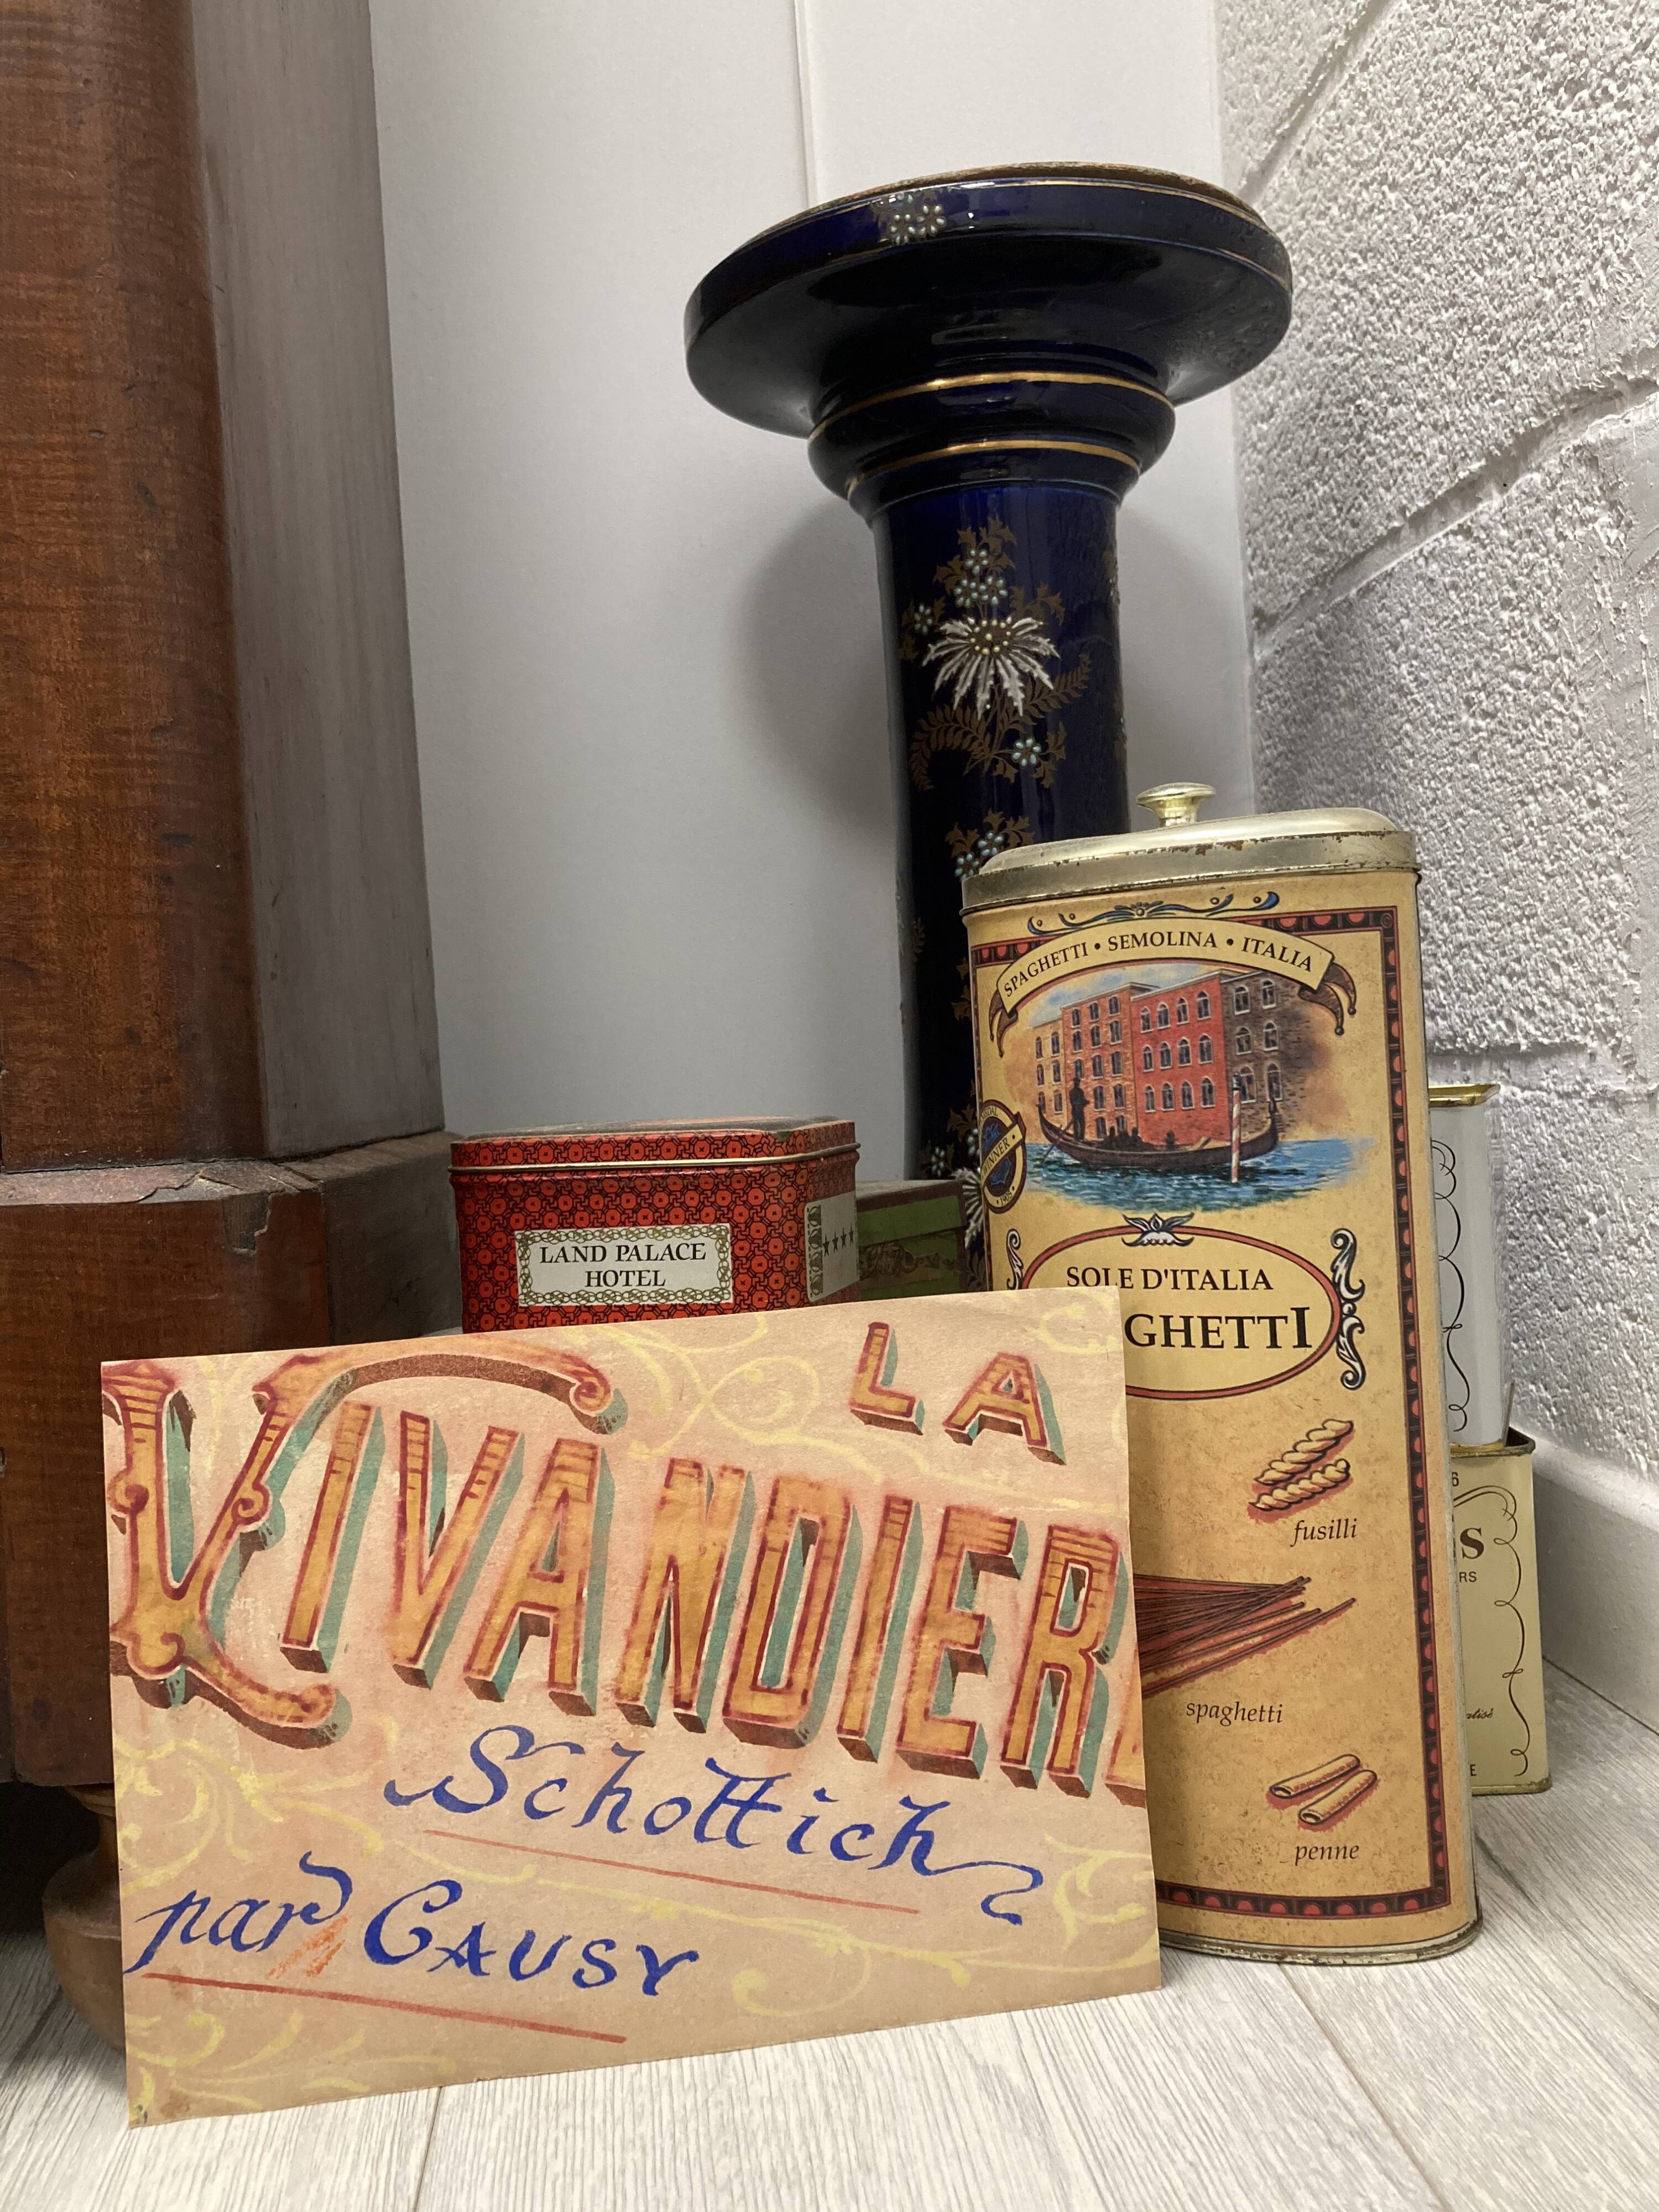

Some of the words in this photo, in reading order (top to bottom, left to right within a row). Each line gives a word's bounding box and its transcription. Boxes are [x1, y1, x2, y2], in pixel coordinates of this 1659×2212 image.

[1003, 941, 1089, 997] SPAGHETTI
[1108, 931, 1218, 951] SEMOLINA
[1243, 937, 1313, 973] ITALIA
[983, 1137, 1010, 1176] WINNER
[1000, 1189, 1013, 1206] 1905
[539, 1245, 607, 1264] LAND
[614, 1241, 707, 1263] PALACE
[585, 1269, 666, 1288] HOTEL
[1067, 1266, 1134, 1289] SOLE
[1141, 1267, 1274, 1291] D'ITALIA
[1124, 1306, 1313, 1349] GHETTI
[848, 1321, 1067, 1464] LA
[1290, 1519, 1357, 1547] fusilli
[1186, 1700, 1284, 1724] spaghetti
[383, 1723, 1045, 1926] Schottich
[1293, 1842, 1360, 1866] penne
[123, 1850, 353, 1974] par
